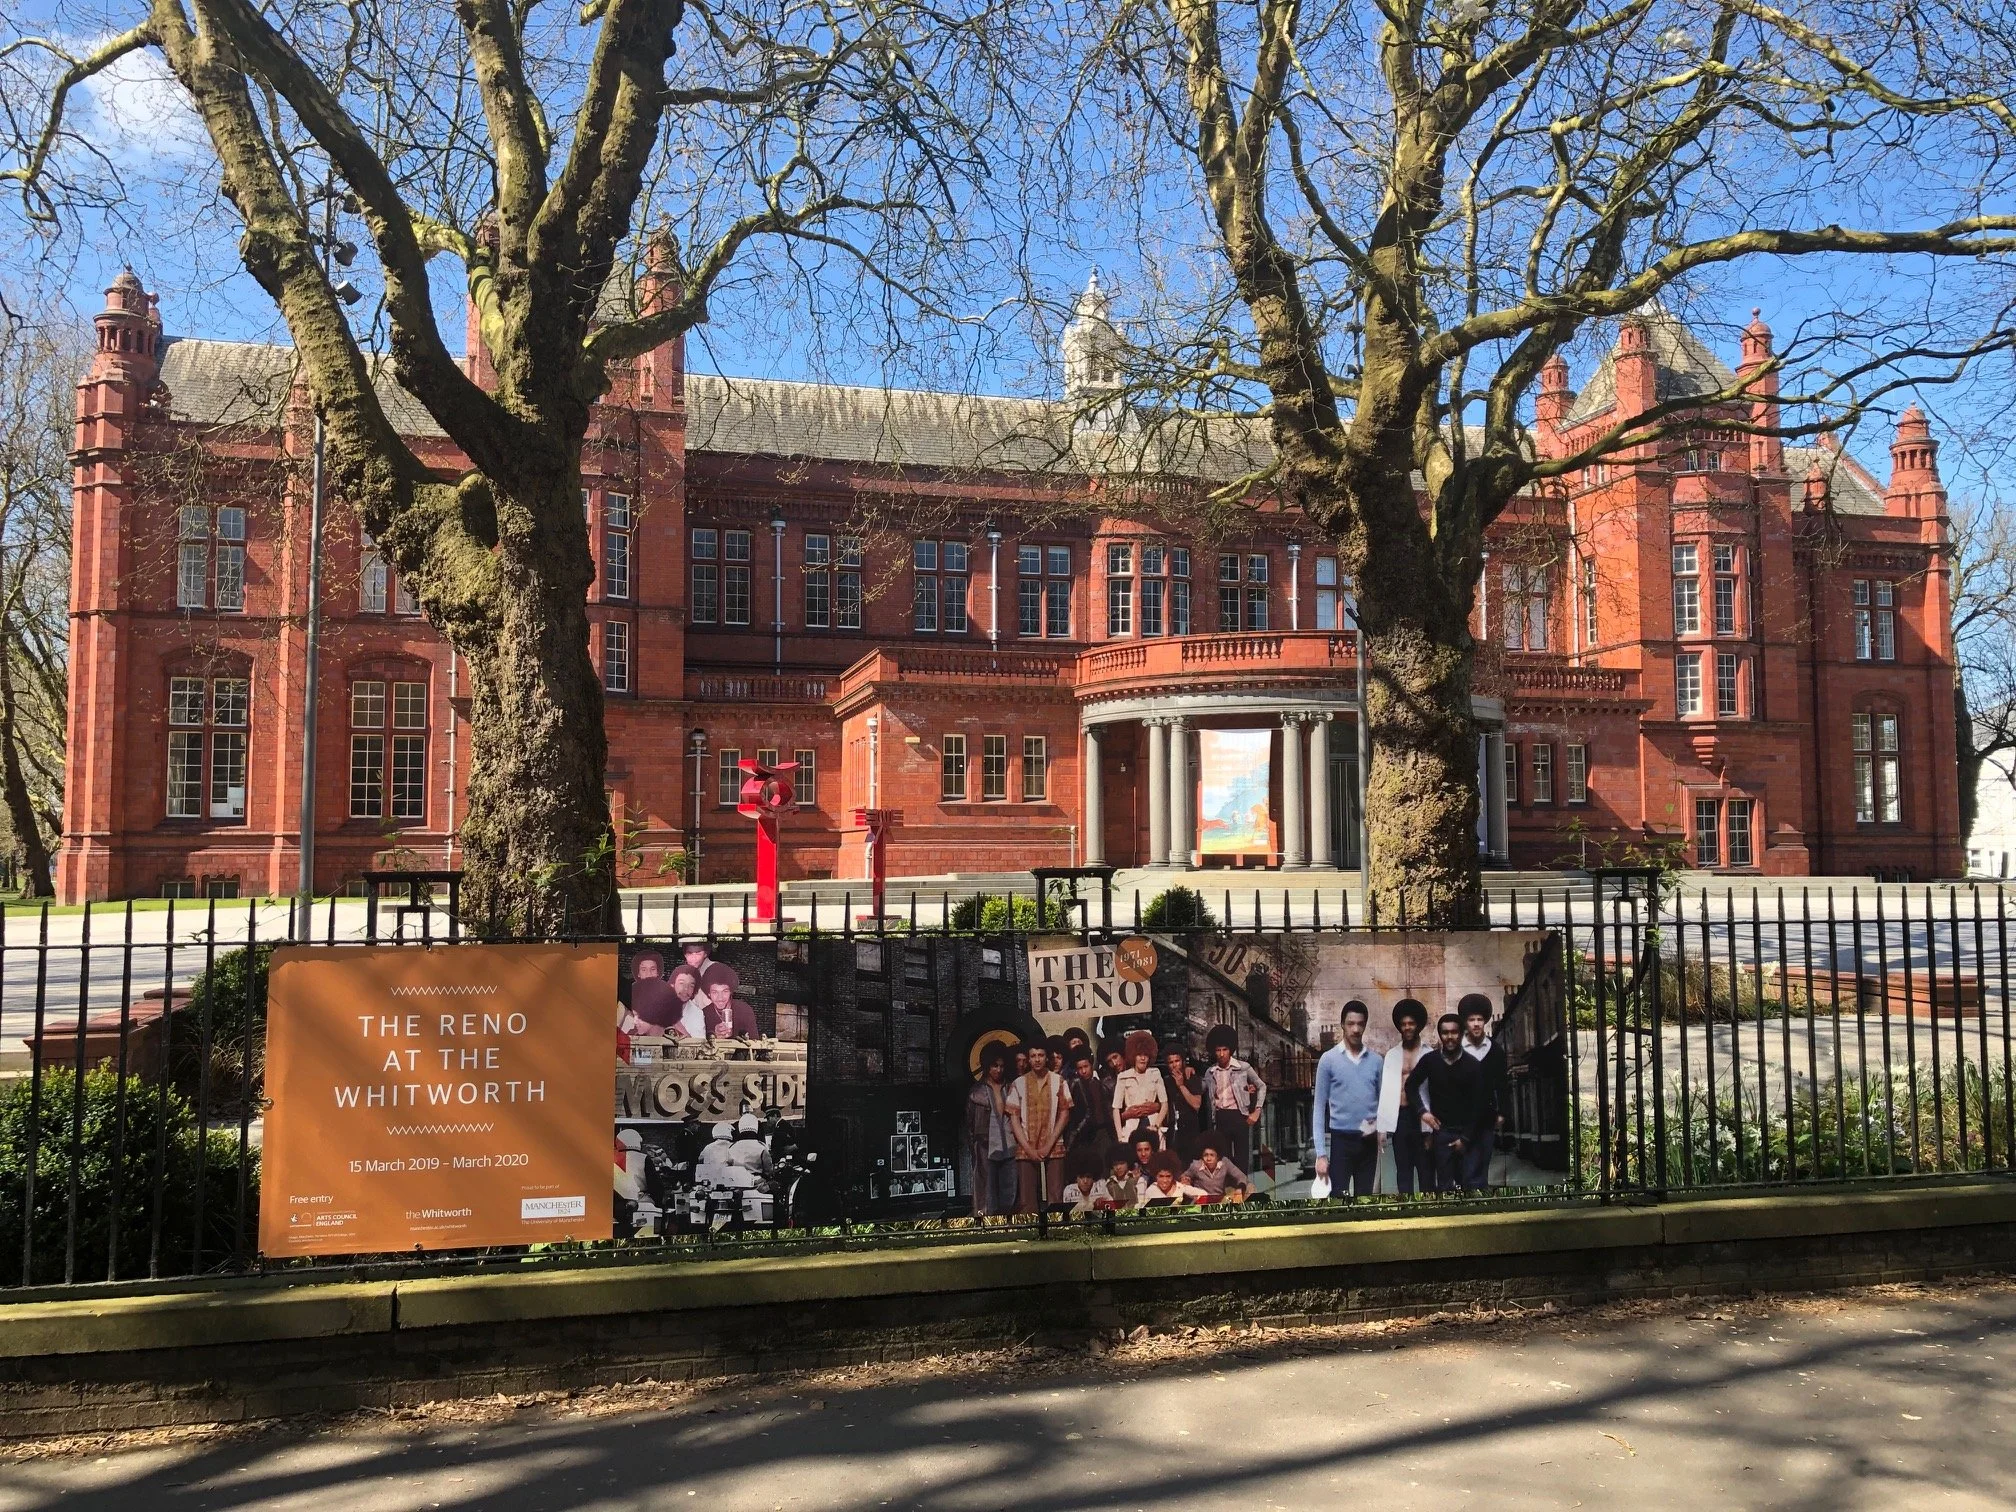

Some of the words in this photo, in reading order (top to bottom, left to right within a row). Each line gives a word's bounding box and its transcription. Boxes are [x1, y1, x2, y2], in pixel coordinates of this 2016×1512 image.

[1035, 952, 1115, 983] THE
[1120, 950, 1140, 963] 1971
[1037, 981, 1144, 1013] RENO
[358, 1014, 421, 1038] THE
[439, 1012, 528, 1036] RENO
[382, 1049, 422, 1072] AT
[438, 1047, 500, 1070] THE
[334, 1080, 545, 1108] WHITWORTH
[615, 1062, 730, 1118] MOSS
[349, 1160, 362, 1173] 15
[365, 1158, 405, 1173] March
[408, 1157, 440, 1171] 2019
[453, 1154, 492, 1169] March
[494, 1153, 529, 1167] 2020
[289, 1195, 309, 1204] Free
[310, 1194, 334, 1204] entry
[525, 1200, 583, 1211] MANCHESTER
[405, 1209, 421, 1220] the
[421, 1207, 472, 1219] Whitworth
